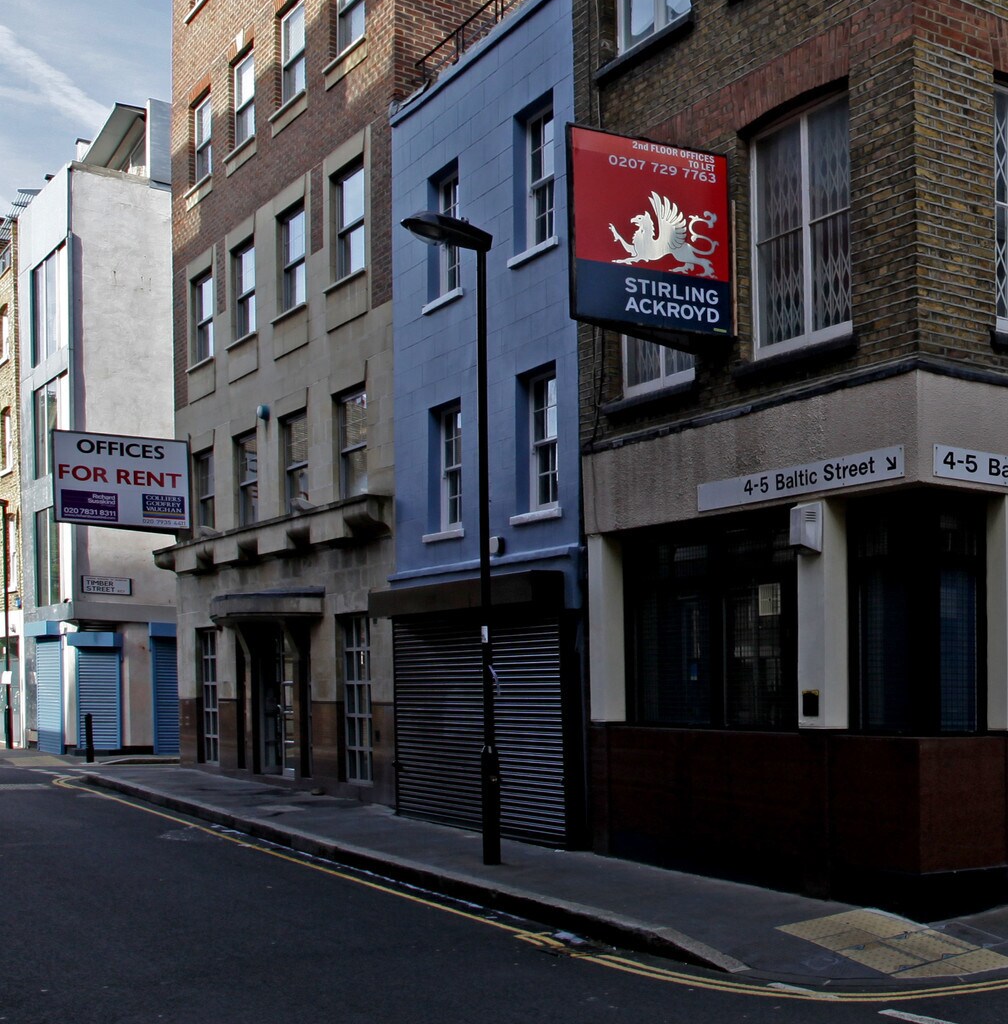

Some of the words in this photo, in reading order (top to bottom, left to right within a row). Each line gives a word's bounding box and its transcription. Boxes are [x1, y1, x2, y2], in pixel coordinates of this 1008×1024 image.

[632, 140, 649, 152] 2nd
[650, 144, 678, 156] FLOOR
[680, 149, 715, 164] OFFICES
[608, 154, 646, 171] 0207
[650, 162, 678, 176] 729
[682, 168, 716, 184] 7763
[689, 160, 698, 170] TO
[699, 162, 716, 172] LET
[625, 277, 719, 304] STIRLING
[625, 296, 720, 323] ACKROYD
[76, 439, 165, 460] OFFICES
[943, 452, 978, 473] 4-5
[58, 464, 109, 484] FOR
[116, 469, 182, 488] RENT
[744, 478, 769, 496] 4-5
[776, 469, 818, 490] Baltic
[823, 456, 876, 482] Street
[146, 494, 182, 502] COLLIERS
[146, 500, 181, 508] GODFREY
[80, 508, 98, 516] 7831
